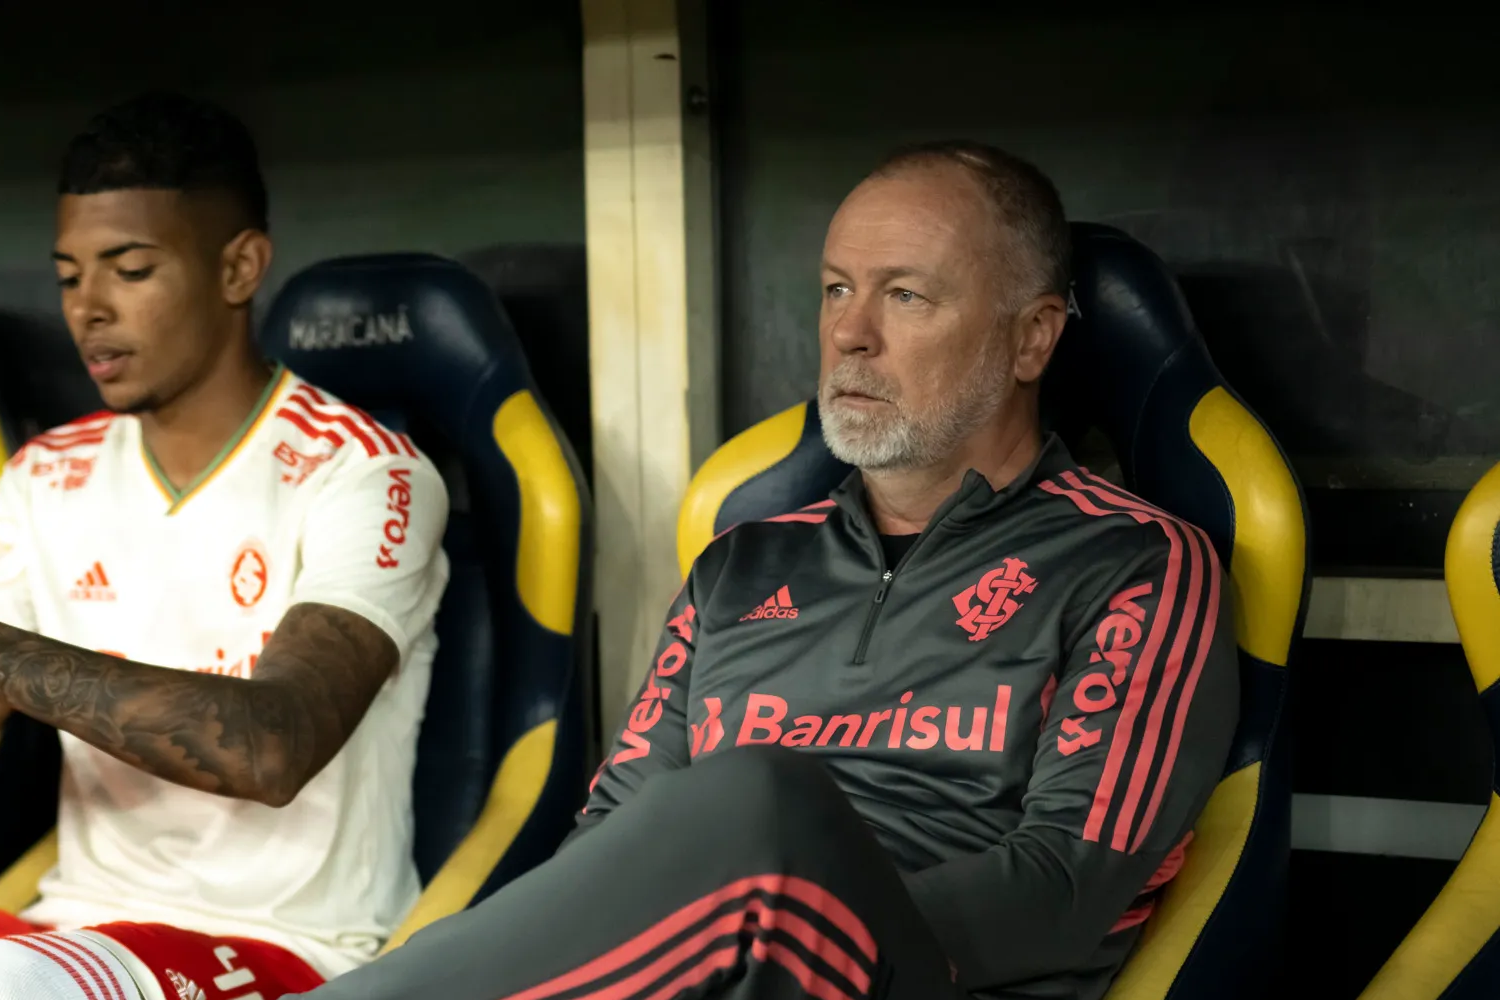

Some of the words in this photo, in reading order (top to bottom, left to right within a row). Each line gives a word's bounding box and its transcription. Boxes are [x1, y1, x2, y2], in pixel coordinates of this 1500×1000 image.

[383, 469, 412, 545] vero
[1073, 582, 1153, 714] vero
[613, 642, 688, 766] vero
[735, 684, 1013, 753] Banrisul
